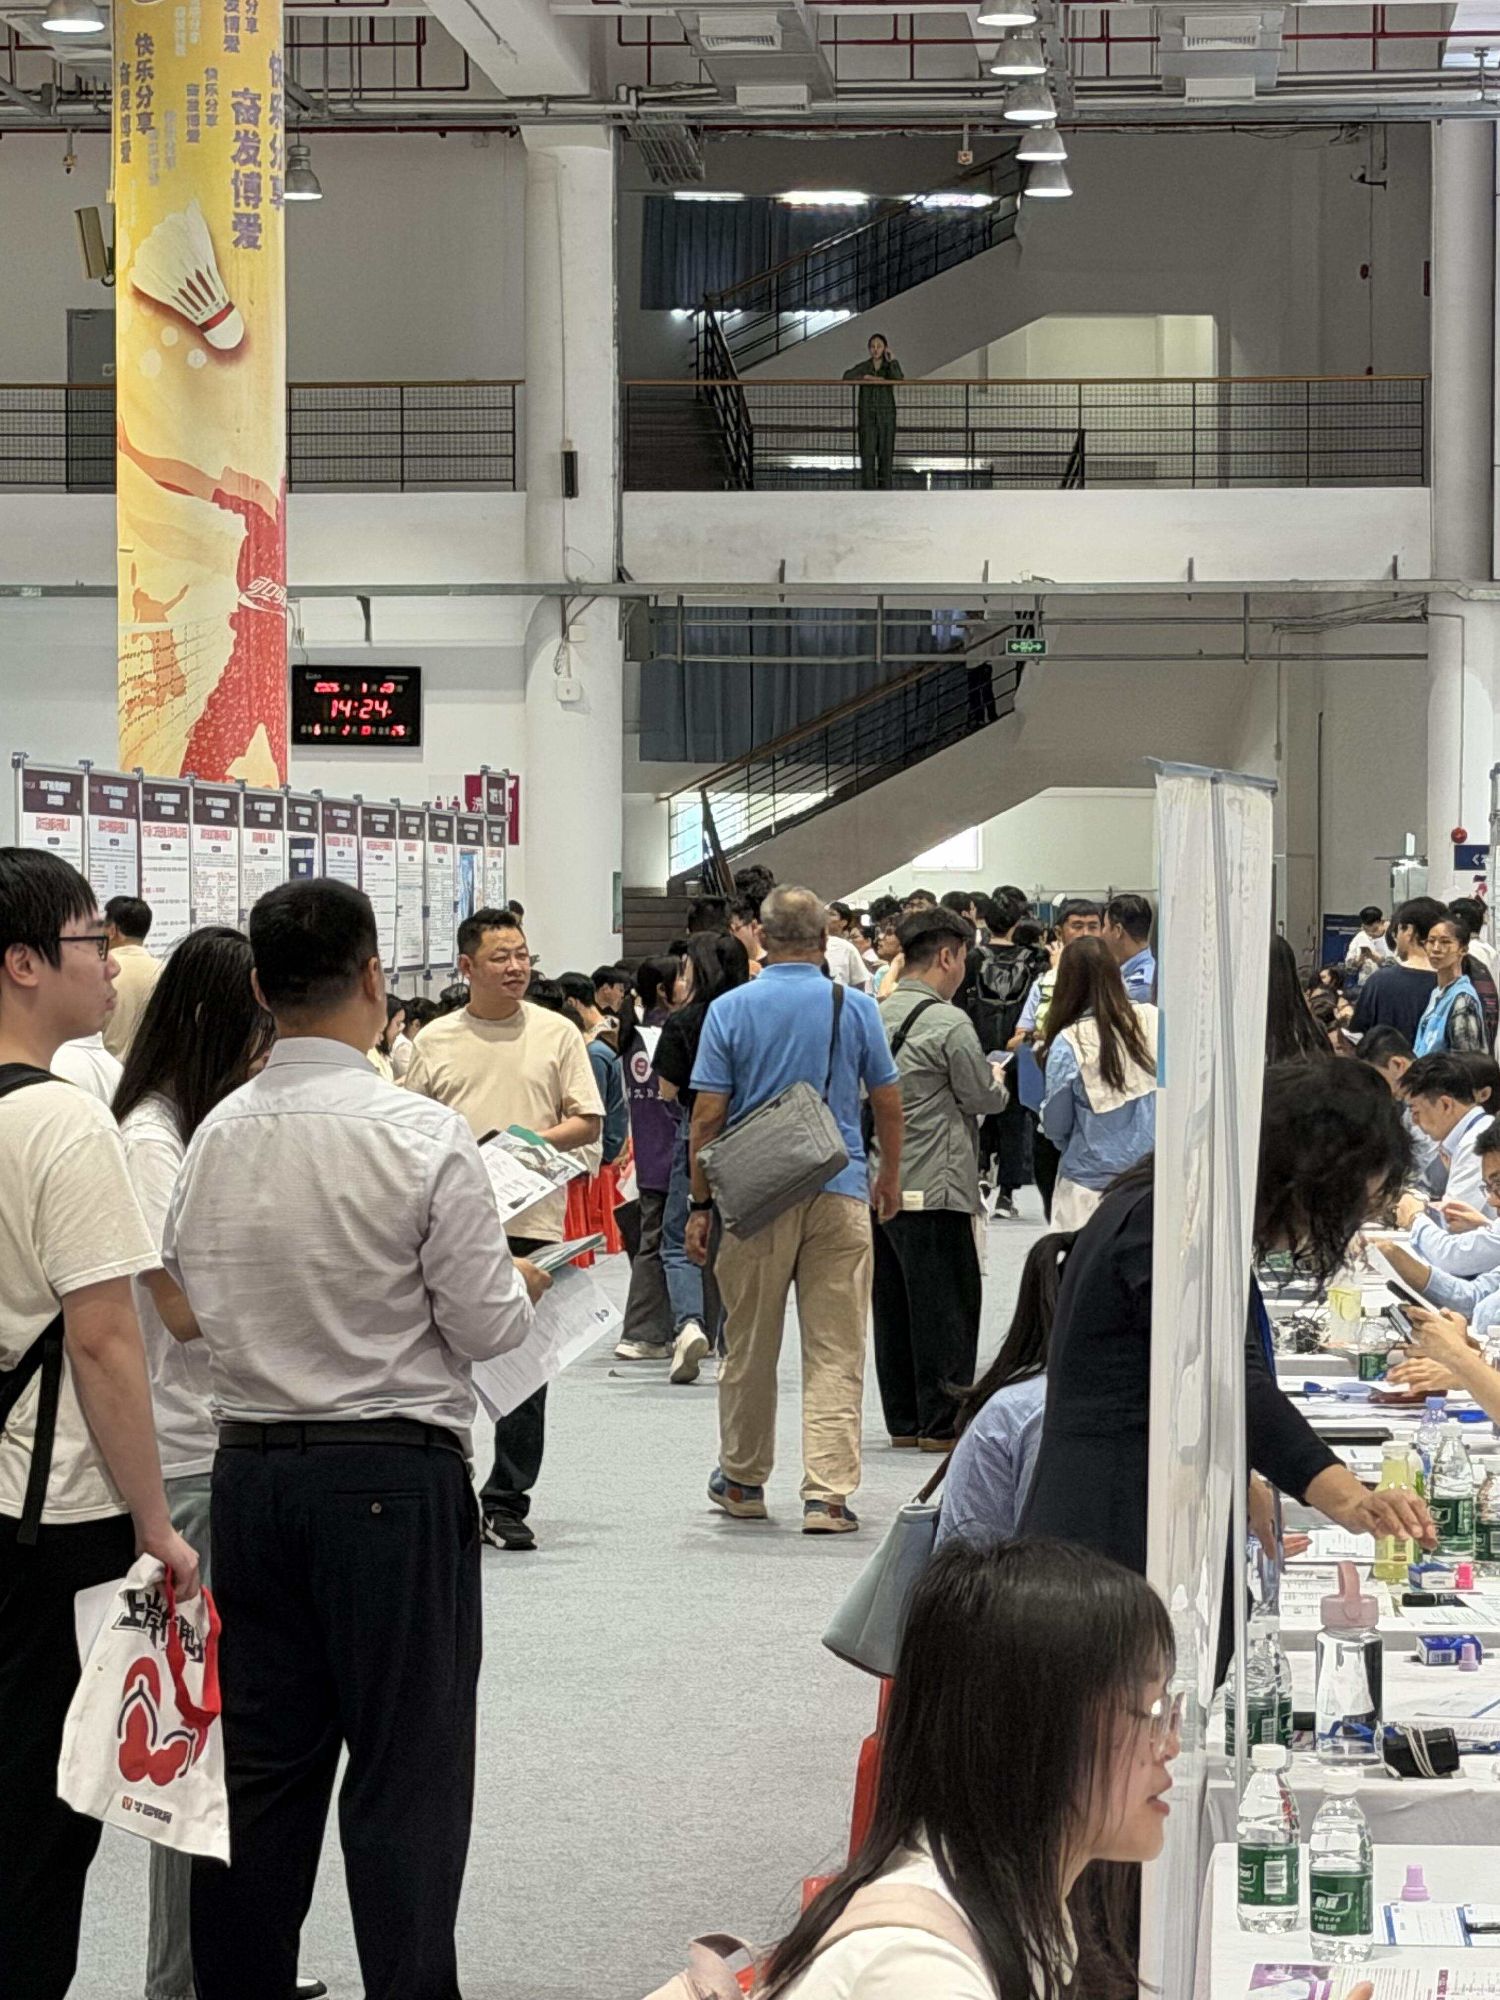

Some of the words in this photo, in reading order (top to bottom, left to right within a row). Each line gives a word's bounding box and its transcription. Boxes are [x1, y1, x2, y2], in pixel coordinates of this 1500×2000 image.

[135, 33, 155, 135] 快乐分享
[331, 699, 388, 718] 14:24
